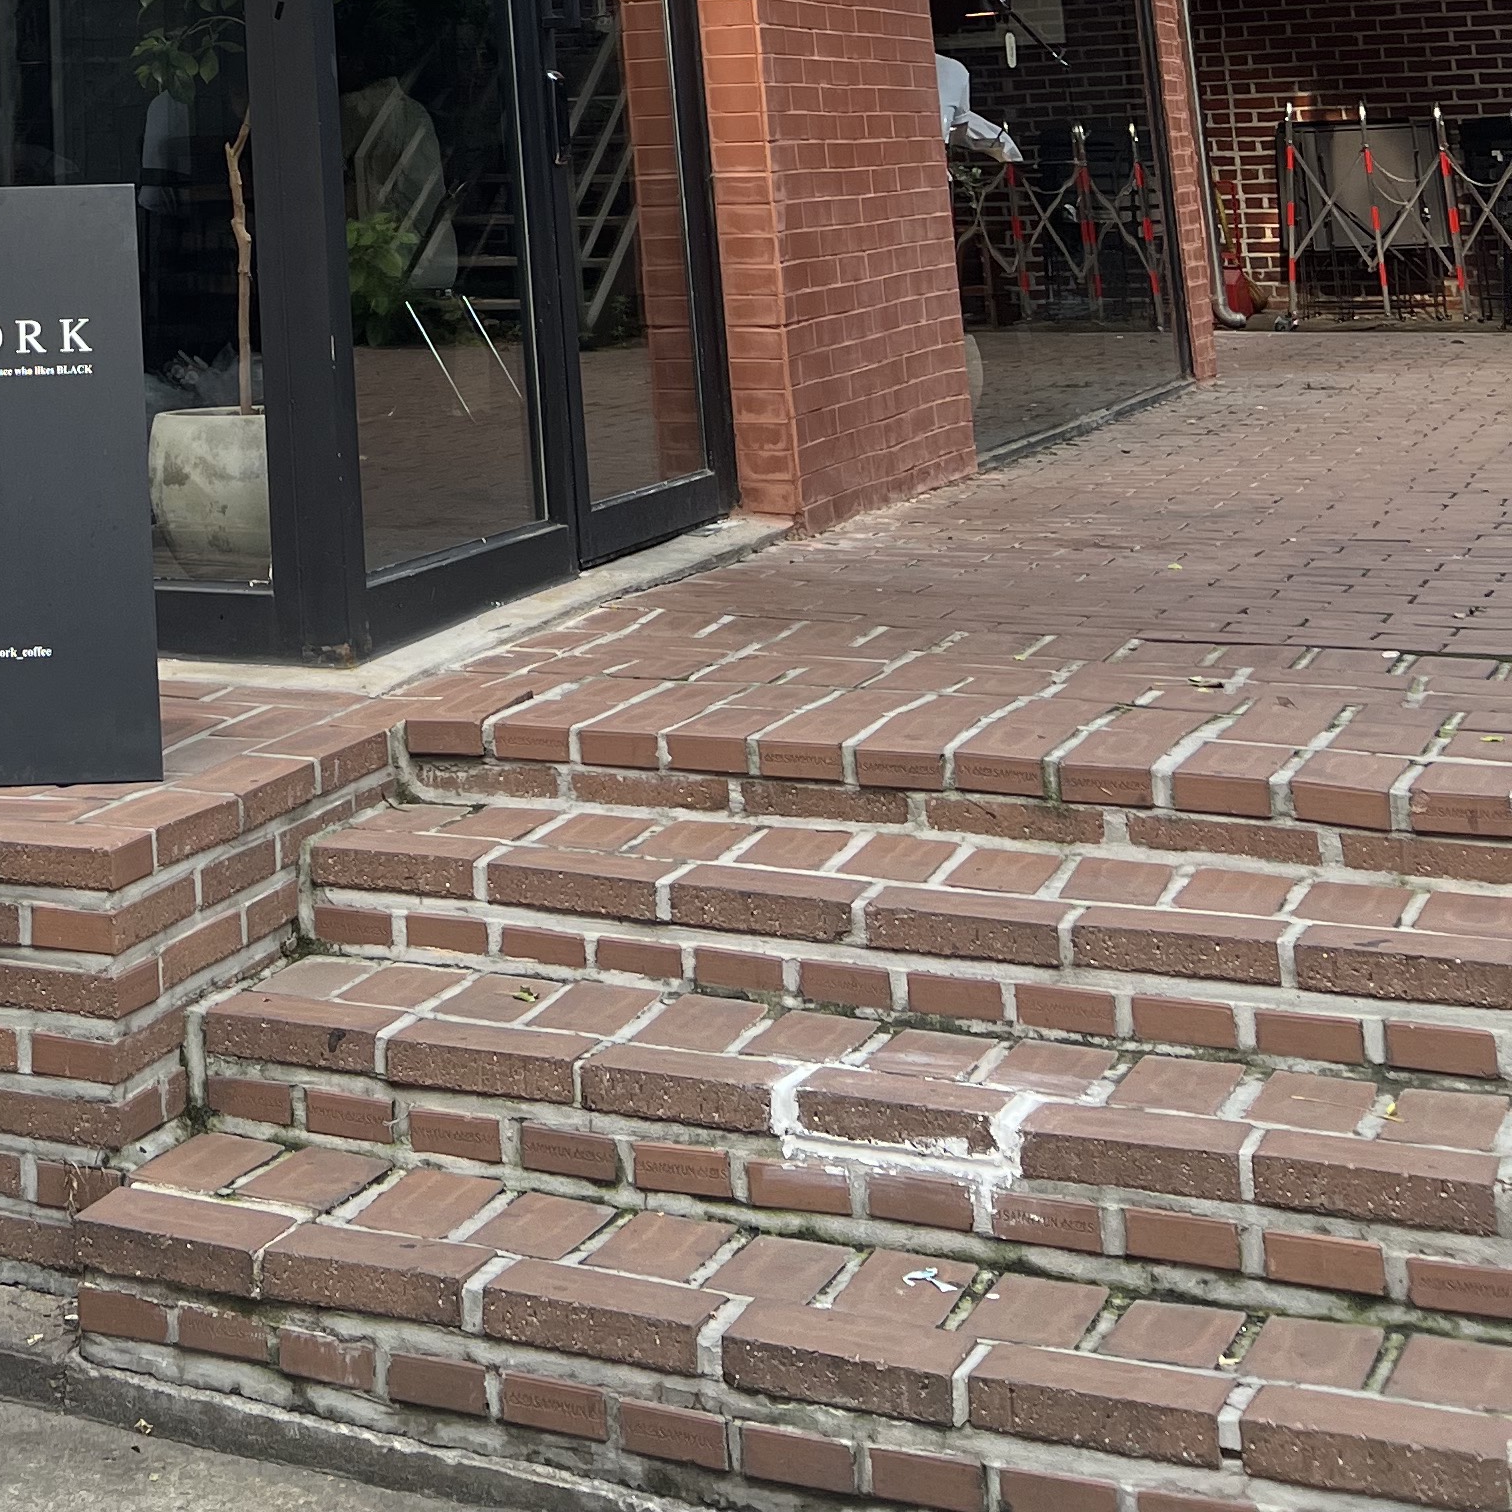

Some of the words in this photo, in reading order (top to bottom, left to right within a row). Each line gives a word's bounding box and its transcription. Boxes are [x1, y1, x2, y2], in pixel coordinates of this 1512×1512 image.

[14, 366, 33, 376] who
[34, 365, 55, 375] likes
[56, 364, 93, 375] BLACK
